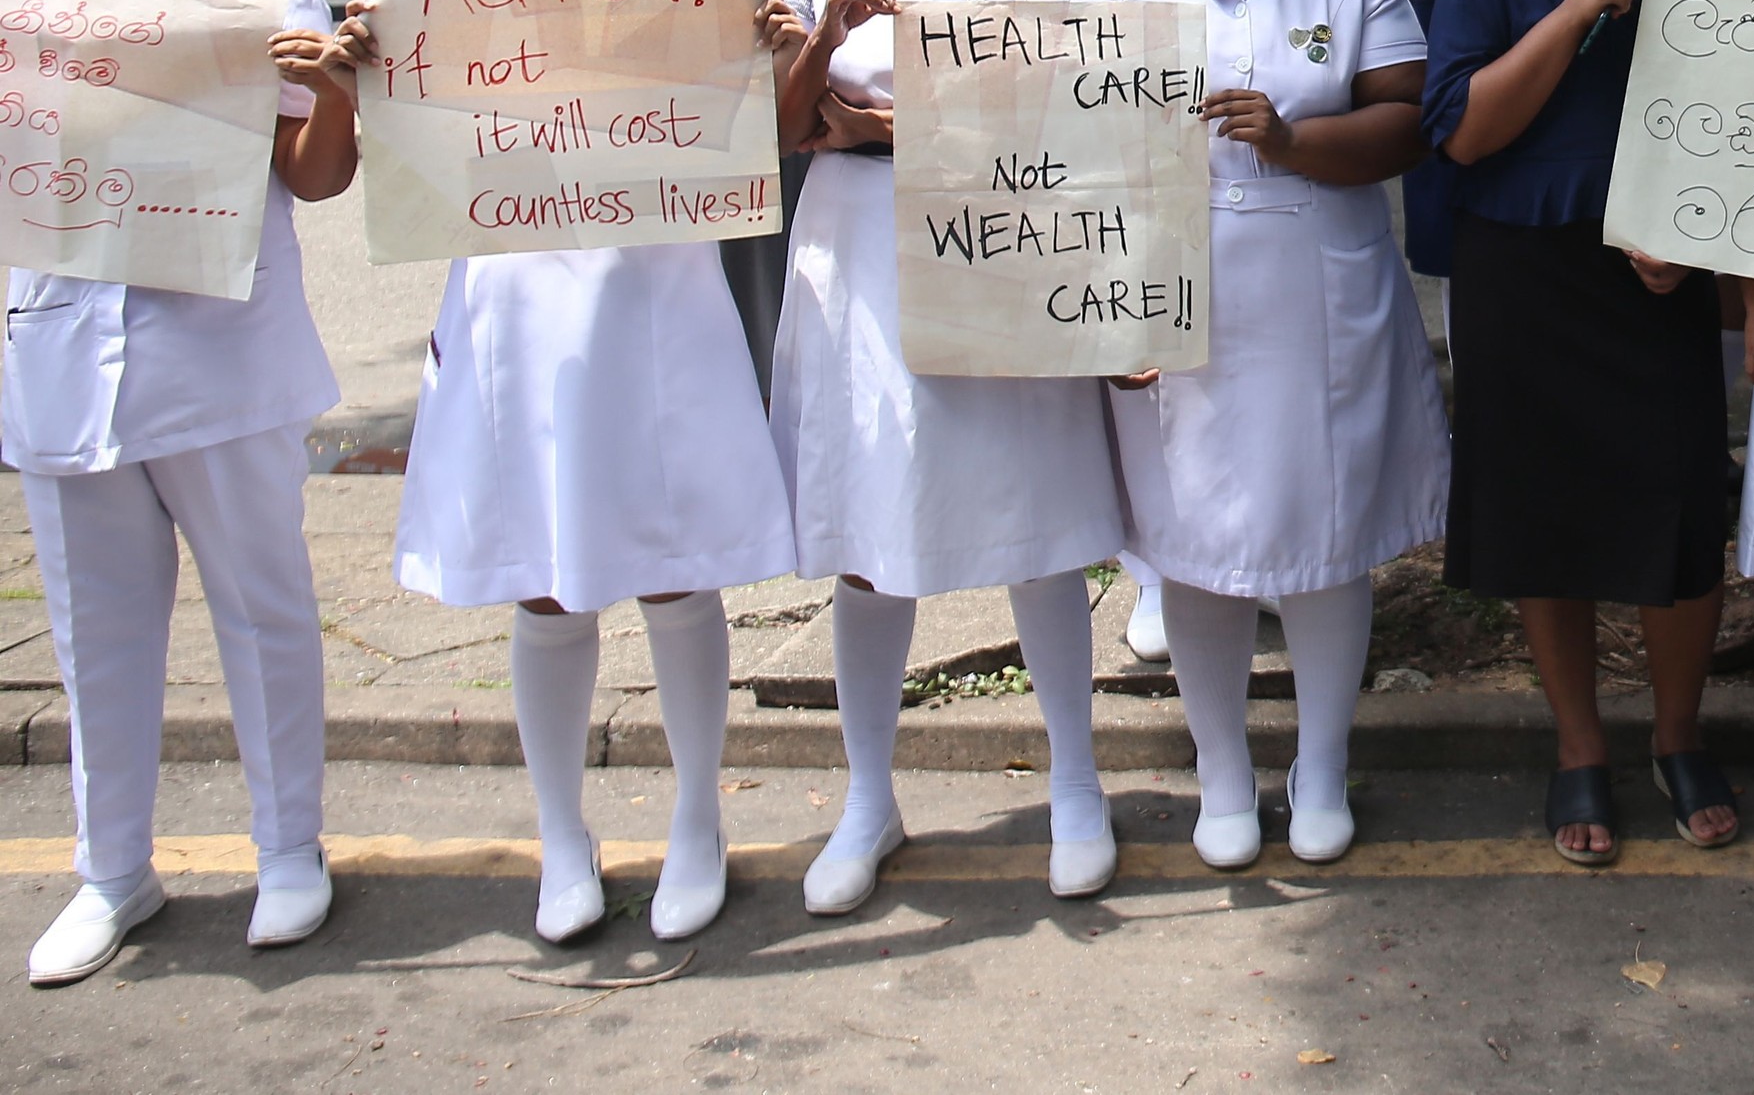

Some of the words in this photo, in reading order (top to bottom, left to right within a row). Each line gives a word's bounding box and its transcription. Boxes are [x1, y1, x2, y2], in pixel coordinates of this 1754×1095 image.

[384, 30, 433, 100] if
[466, 38, 549, 88] not
[919, 11, 1127, 69] HEALTH
[1072, 65, 1206, 116] CARE!!
[473, 109, 519, 158] it
[532, 97, 592, 154] will
[608, 96, 703, 149] cost
[658, 176, 766, 226] lives!!
[991, 151, 1068, 195] Not
[925, 204, 1130, 266] WEALTH
[1046, 274, 1195, 332] CARE!!
